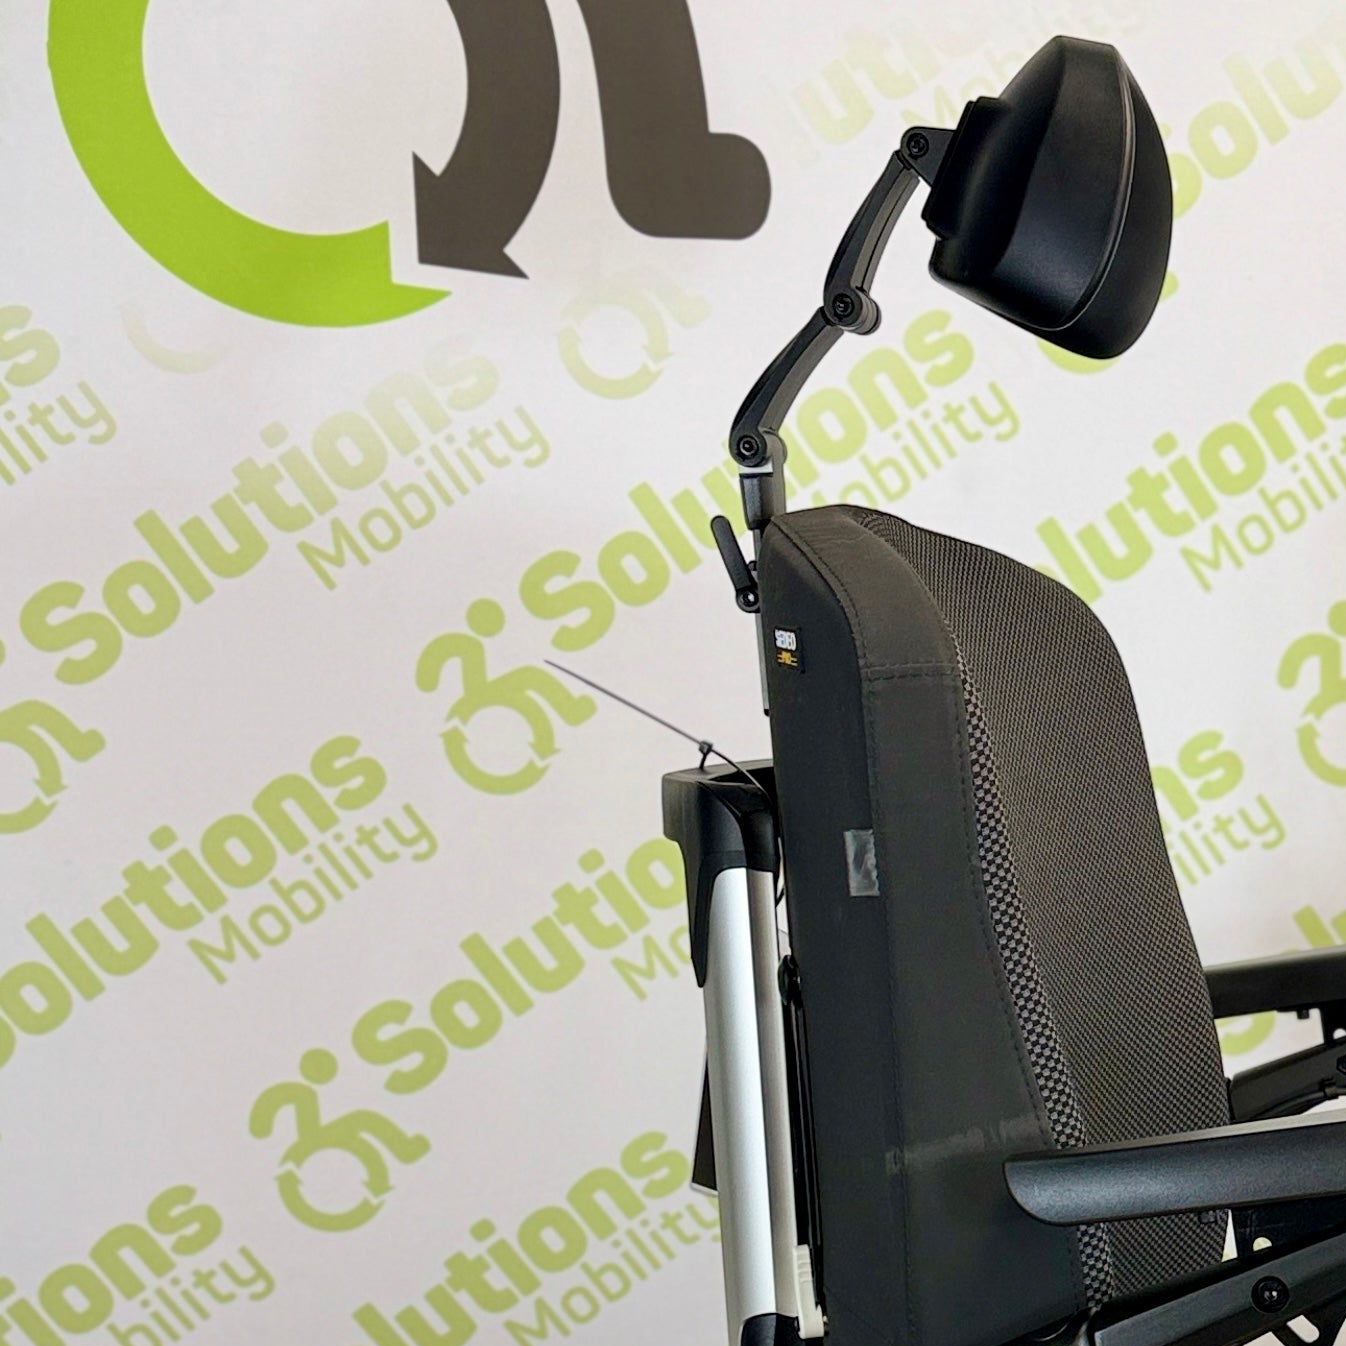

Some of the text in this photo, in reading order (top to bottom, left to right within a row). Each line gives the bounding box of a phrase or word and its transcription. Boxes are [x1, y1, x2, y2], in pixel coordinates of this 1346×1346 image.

[18, 347, 500, 685] Solutions
[297, 405, 551, 590] Mobility
[805, 381, 1020, 512] obility
[0, 735, 388, 1070] olutions
[188, 802, 439, 985] Mobility
[351, 837, 686, 1094] Solutio
